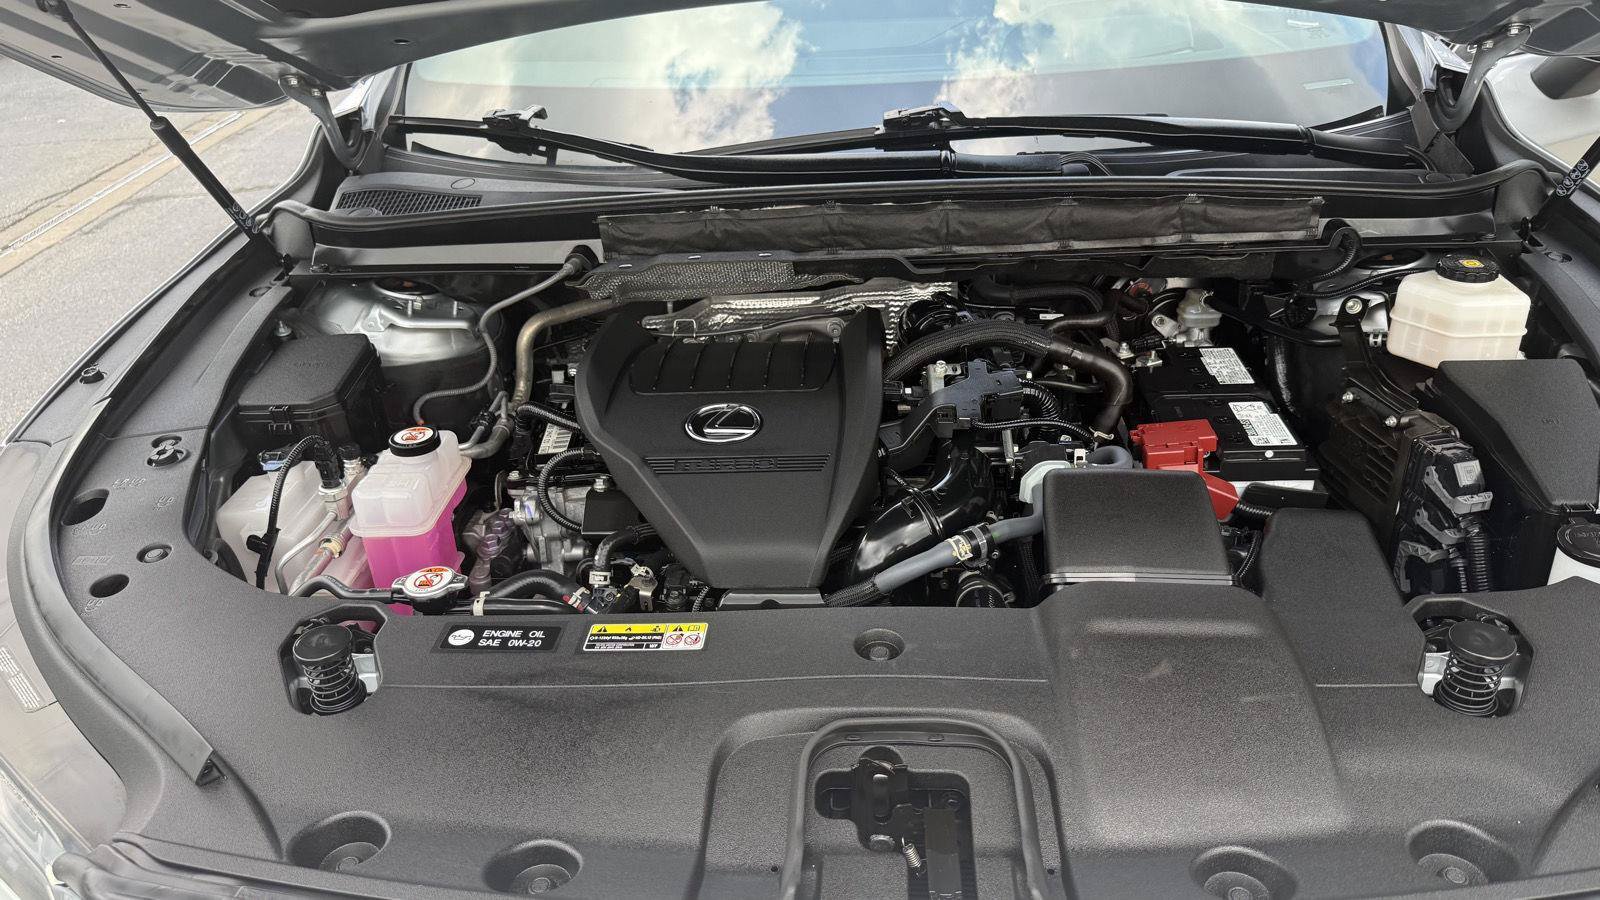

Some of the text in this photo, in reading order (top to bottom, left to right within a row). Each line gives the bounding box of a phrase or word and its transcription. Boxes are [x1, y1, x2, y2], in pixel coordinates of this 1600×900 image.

[482, 629, 546, 638] ENGINE OIL
[477, 638, 542, 647] SAE 0W-20
